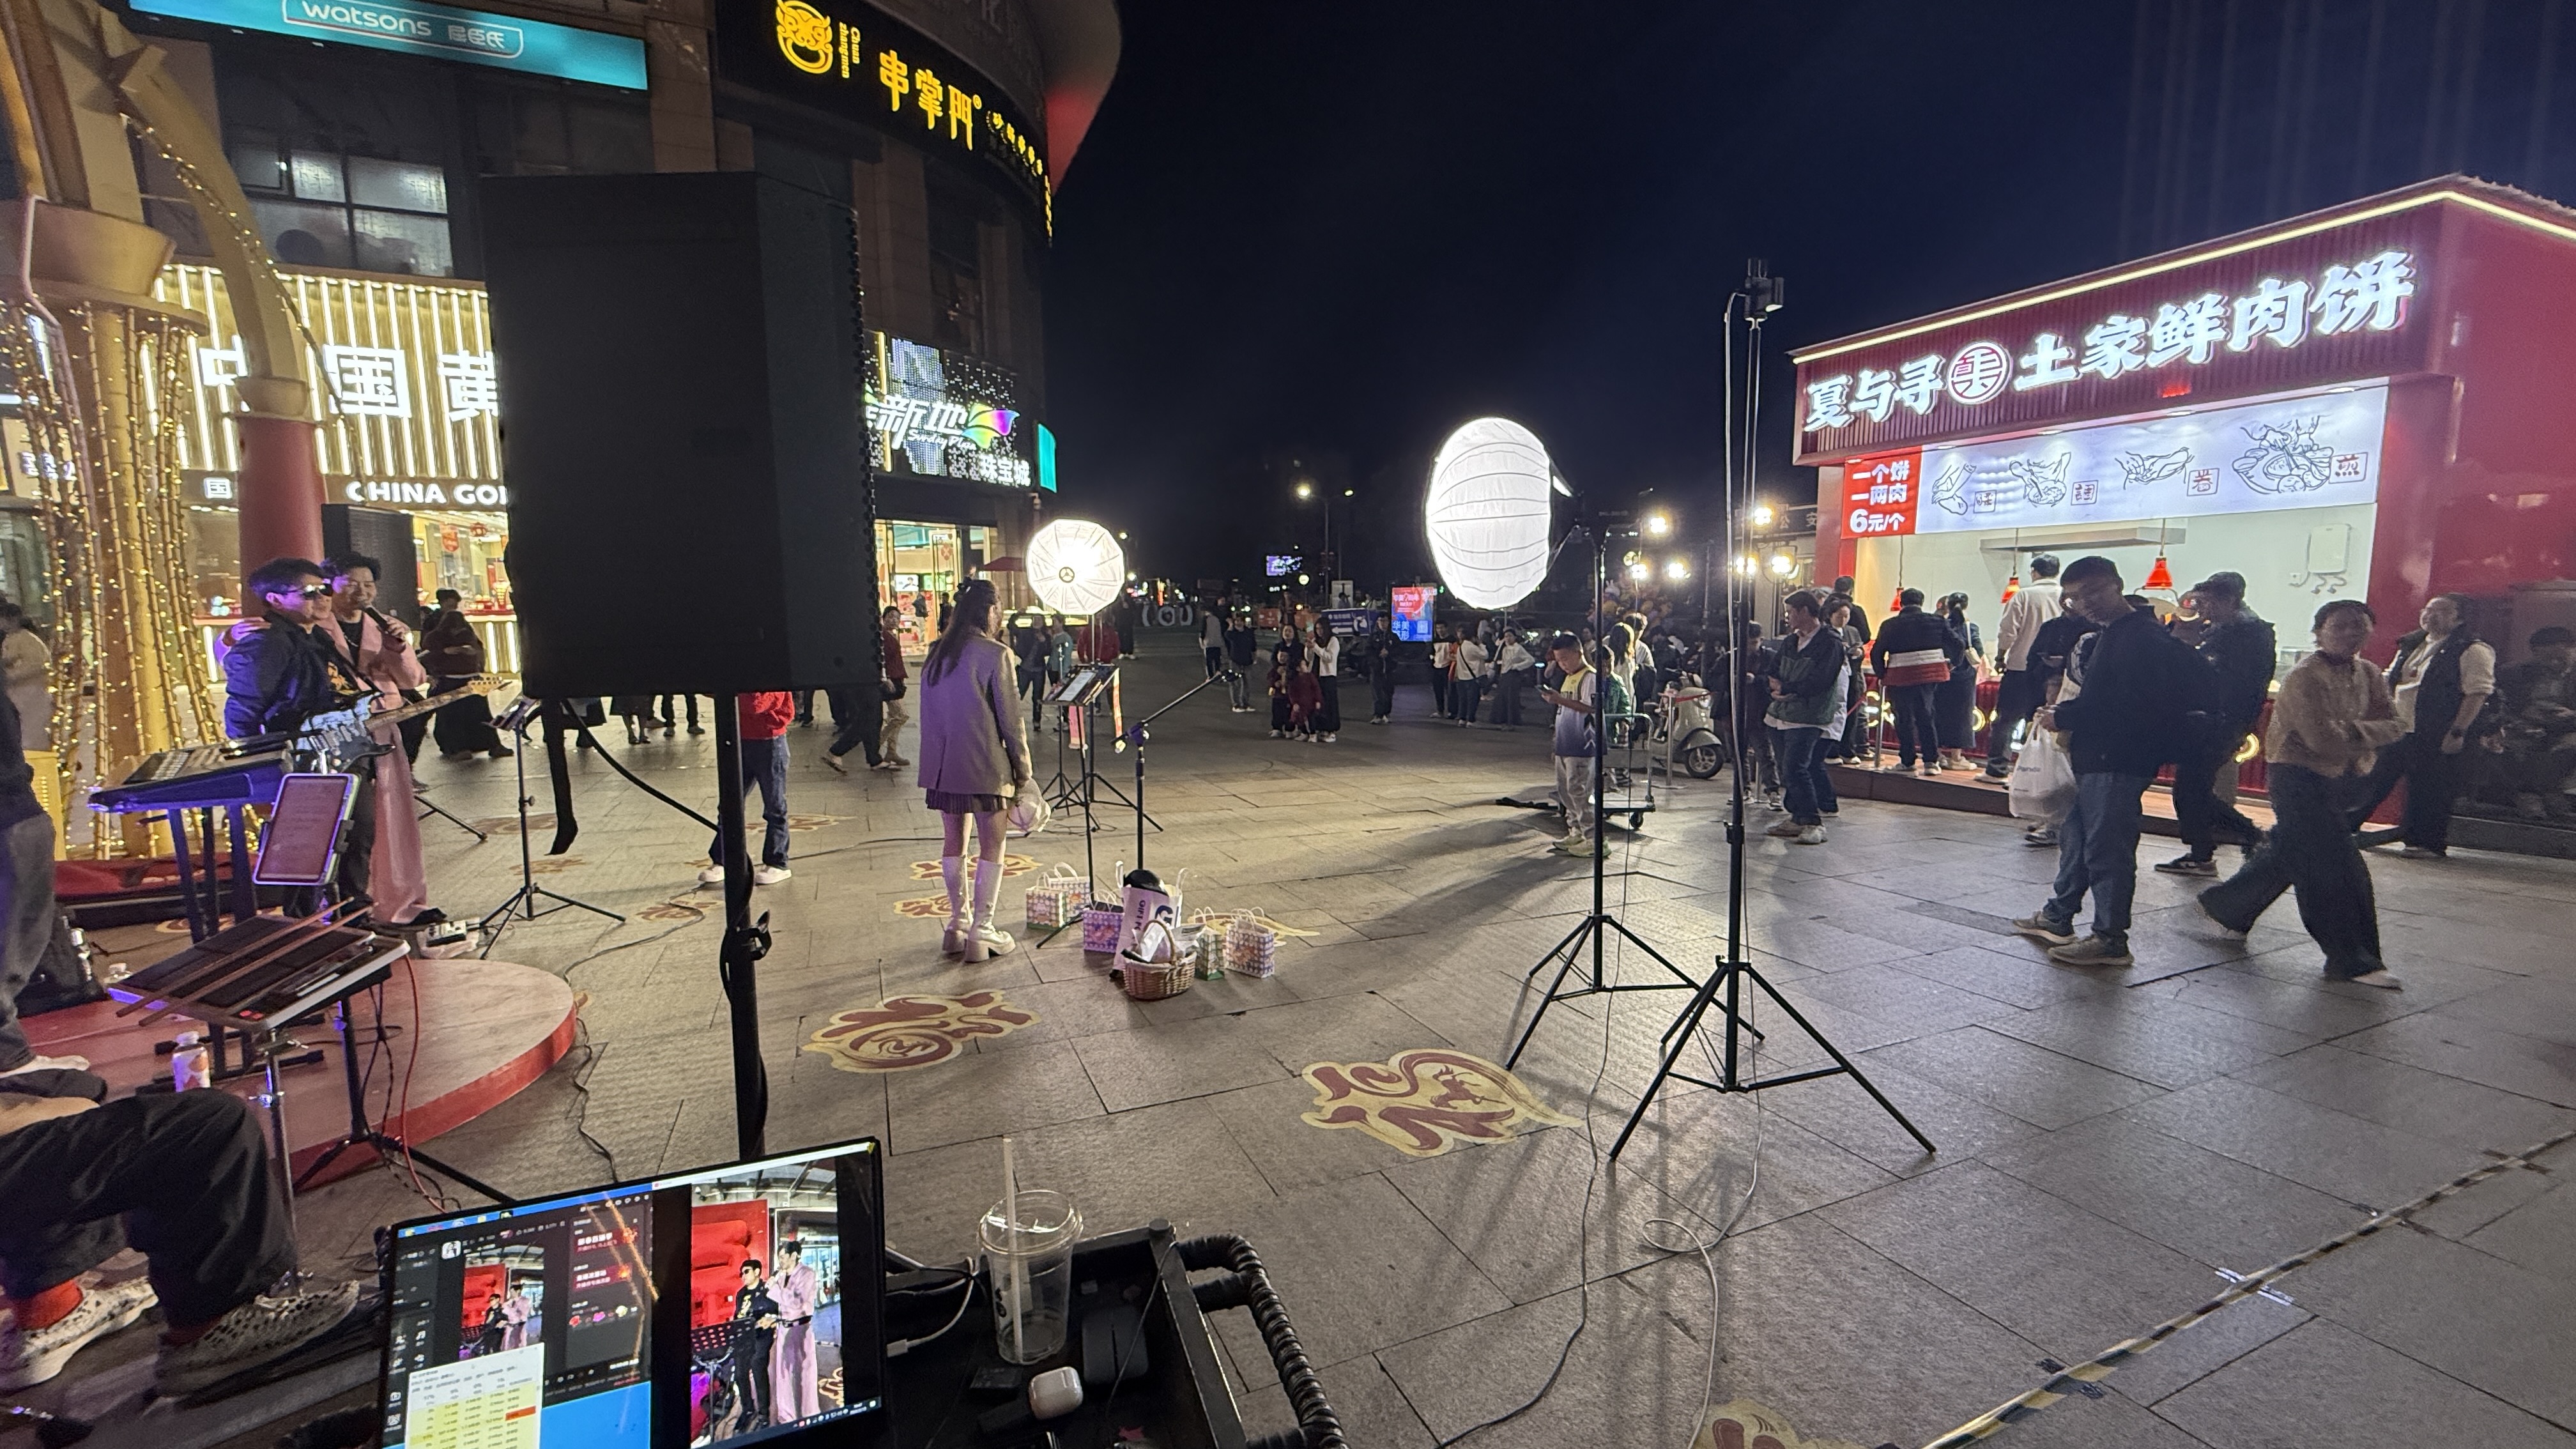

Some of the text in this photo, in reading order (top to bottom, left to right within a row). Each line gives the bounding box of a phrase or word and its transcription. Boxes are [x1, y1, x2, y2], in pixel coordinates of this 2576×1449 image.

[302, 0, 432, 36] watsons
[1804, 353, 1945, 433] 夏与寻
[2014, 250, 2418, 391] 土家鲜肉饼
[1852, 459, 1910, 484] 一个饼
[346, 481, 447, 504] CHINA
[1851, 483, 1908, 505] 一两肉
[1850, 509, 1905, 533] 6元/个
